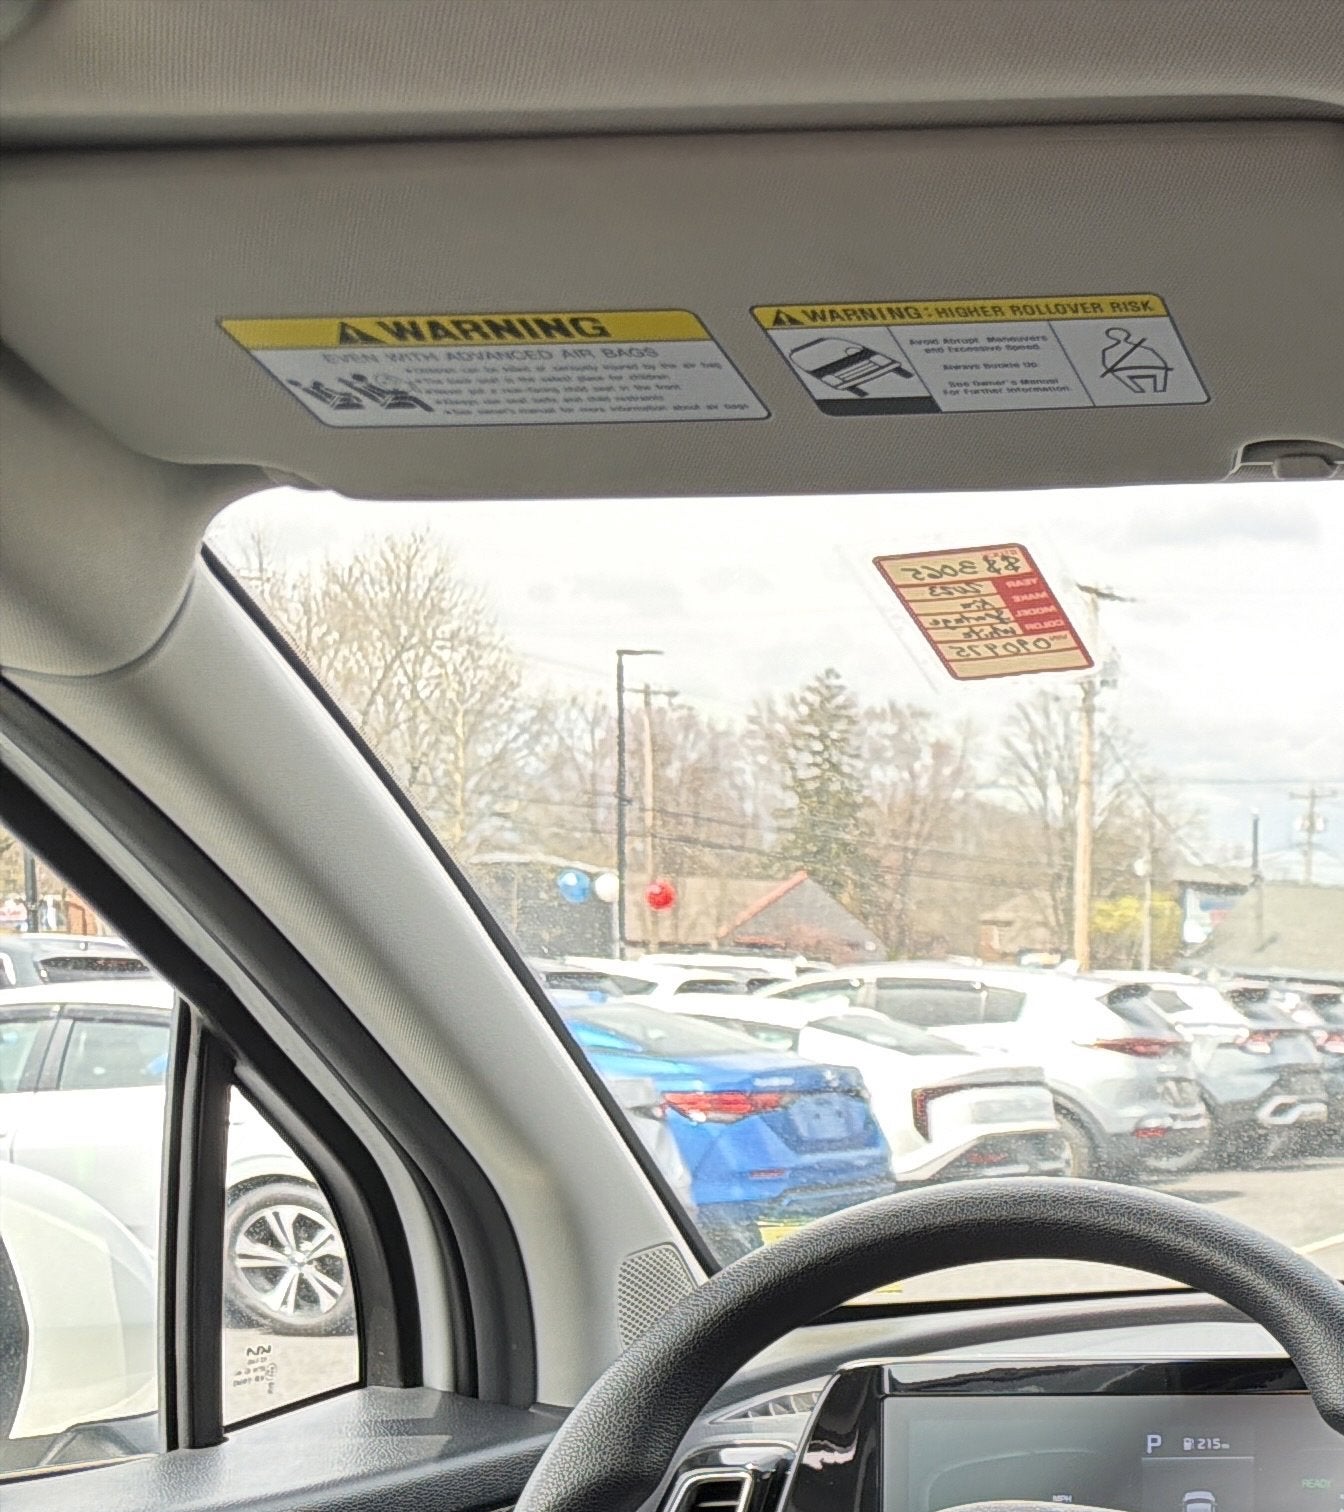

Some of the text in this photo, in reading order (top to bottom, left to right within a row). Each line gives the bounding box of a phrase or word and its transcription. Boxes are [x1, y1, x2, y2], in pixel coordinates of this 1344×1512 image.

[938, 305, 1009, 318] HIGHER
[1012, 302, 1102, 316] ROLLOVER
[1110, 300, 1155, 313] RISK
[377, 316, 611, 341] WARNING
[447, 350, 553, 361] ADVANCED
[561, 348, 596, 359] AIR
[602, 347, 660, 359] BAGS
[1146, 1434, 1221, 1454] P 215
[1302, 1478, 1331, 1489] READY
